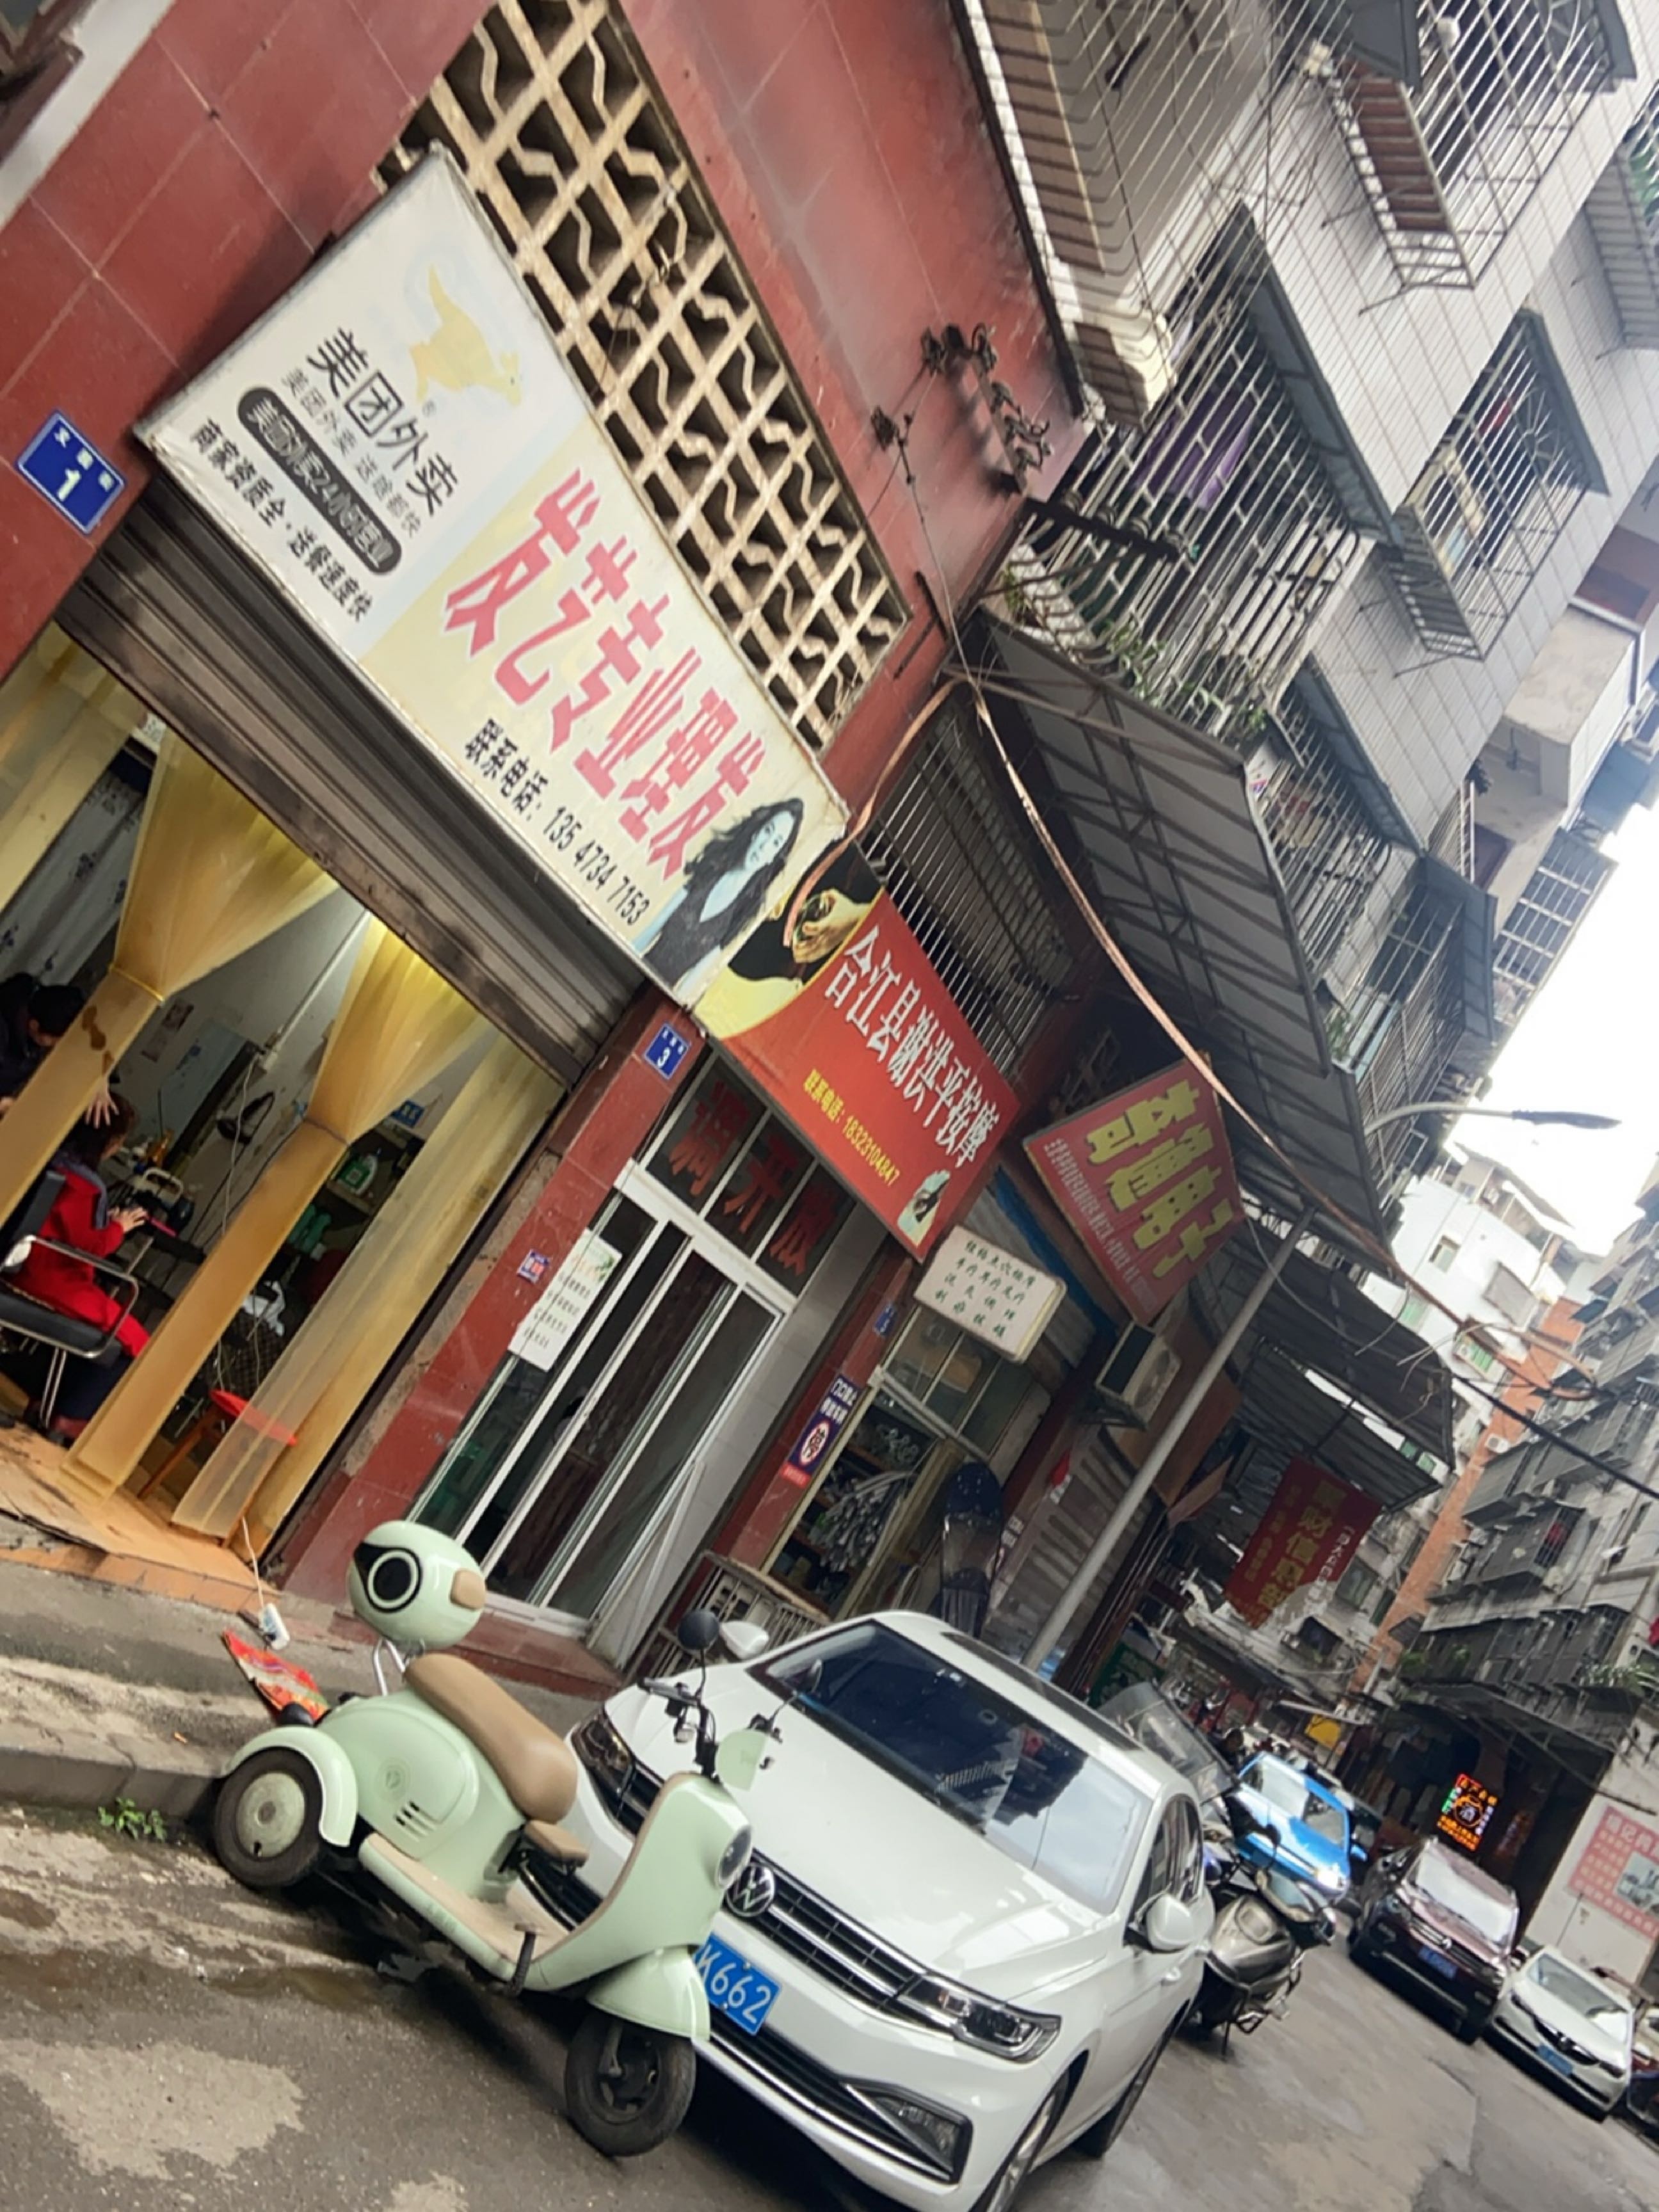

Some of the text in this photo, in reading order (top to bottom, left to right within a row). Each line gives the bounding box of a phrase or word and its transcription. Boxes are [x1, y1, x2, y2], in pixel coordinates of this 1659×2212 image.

[57, 469, 81, 502] 1
[244, 396, 396, 570] 美团外卖24小时营业
[280, 365, 361, 458] 美团外卖
[307, 327, 459, 515] 美团外卖
[444, 466, 765, 881] 发艺专业理发
[541, 805, 583, 853] 135
[572, 839, 618, 892] 4734
[605, 877, 651, 927] 7153
